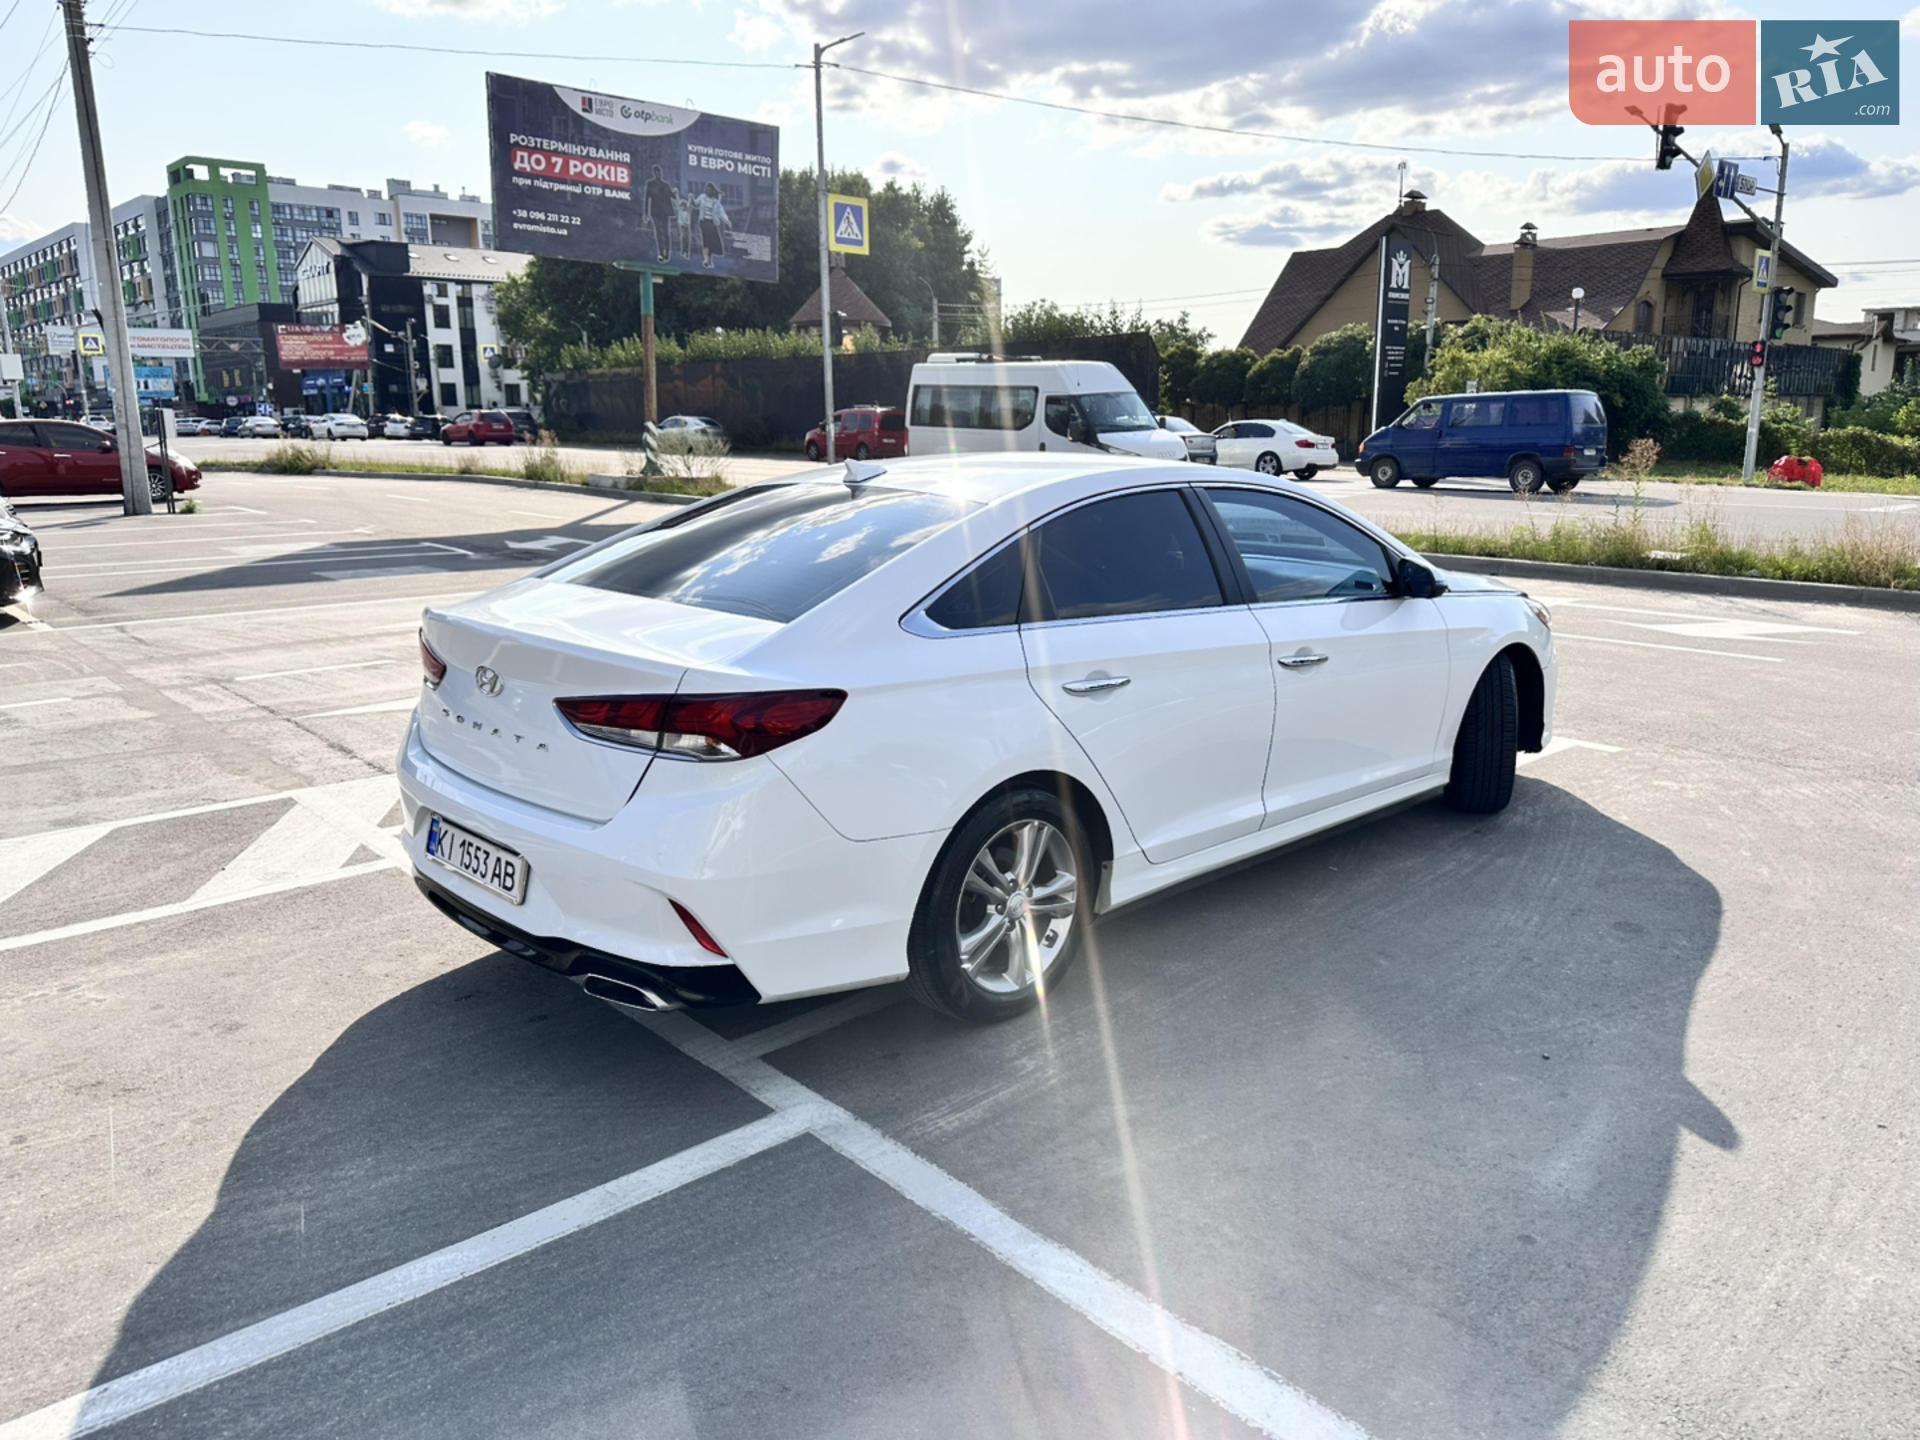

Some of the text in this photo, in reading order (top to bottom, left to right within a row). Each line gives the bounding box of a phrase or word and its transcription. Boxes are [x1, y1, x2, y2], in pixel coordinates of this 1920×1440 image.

[509, 133, 631, 163] РОЗТЕРМІНУВАННЯ
[687, 143, 772, 165] КУПУЙ ГОТОВЕ ЖИТЛО
[513, 150, 629, 183] ДО 7 РОКІВ
[688, 154, 771, 178] В ЕВРО МІСТІ
[512, 176, 631, 200] при підтримці OTP BANK
[1739, 177, 1756, 192] STOP
[512, 221, 568, 236] evromisto.ua
[441, 708, 549, 752] SONATA
[436, 826, 455, 861] KI
[459, 838, 491, 879] 1553
[490, 856, 516, 892] AB
